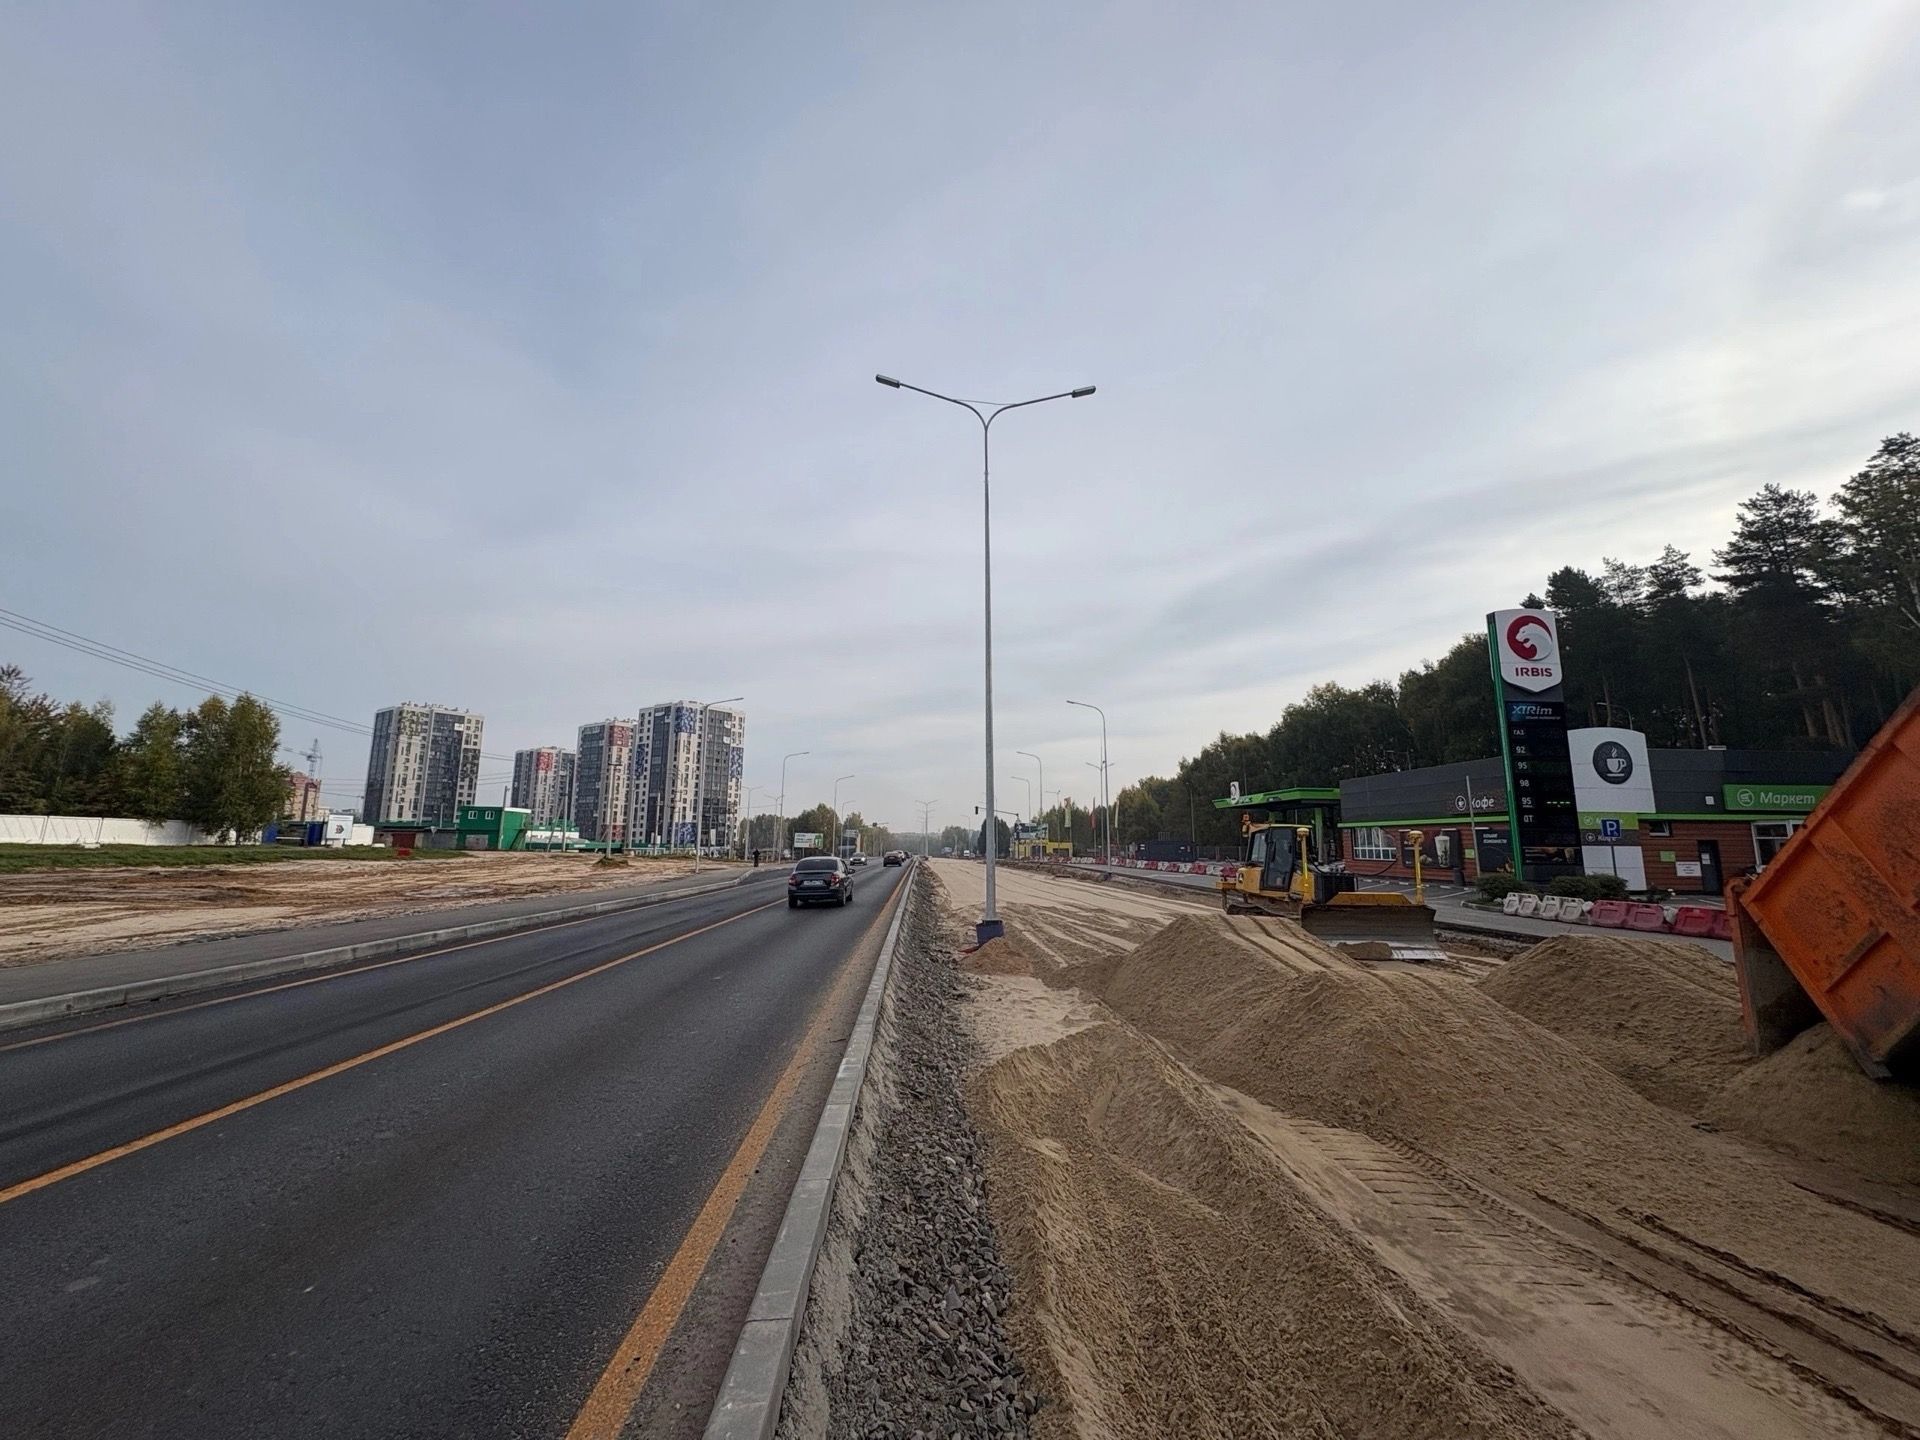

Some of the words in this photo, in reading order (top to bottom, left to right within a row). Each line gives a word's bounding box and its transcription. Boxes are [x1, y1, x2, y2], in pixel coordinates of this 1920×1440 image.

[1515, 667, 1553, 677] IRBIS
[1515, 746, 1526, 754] 92
[1517, 761, 1528, 770] 95
[1519, 779, 1530, 787] 98
[1521, 796, 1532, 805] 95
[1760, 792, 1816, 807] Маркет
